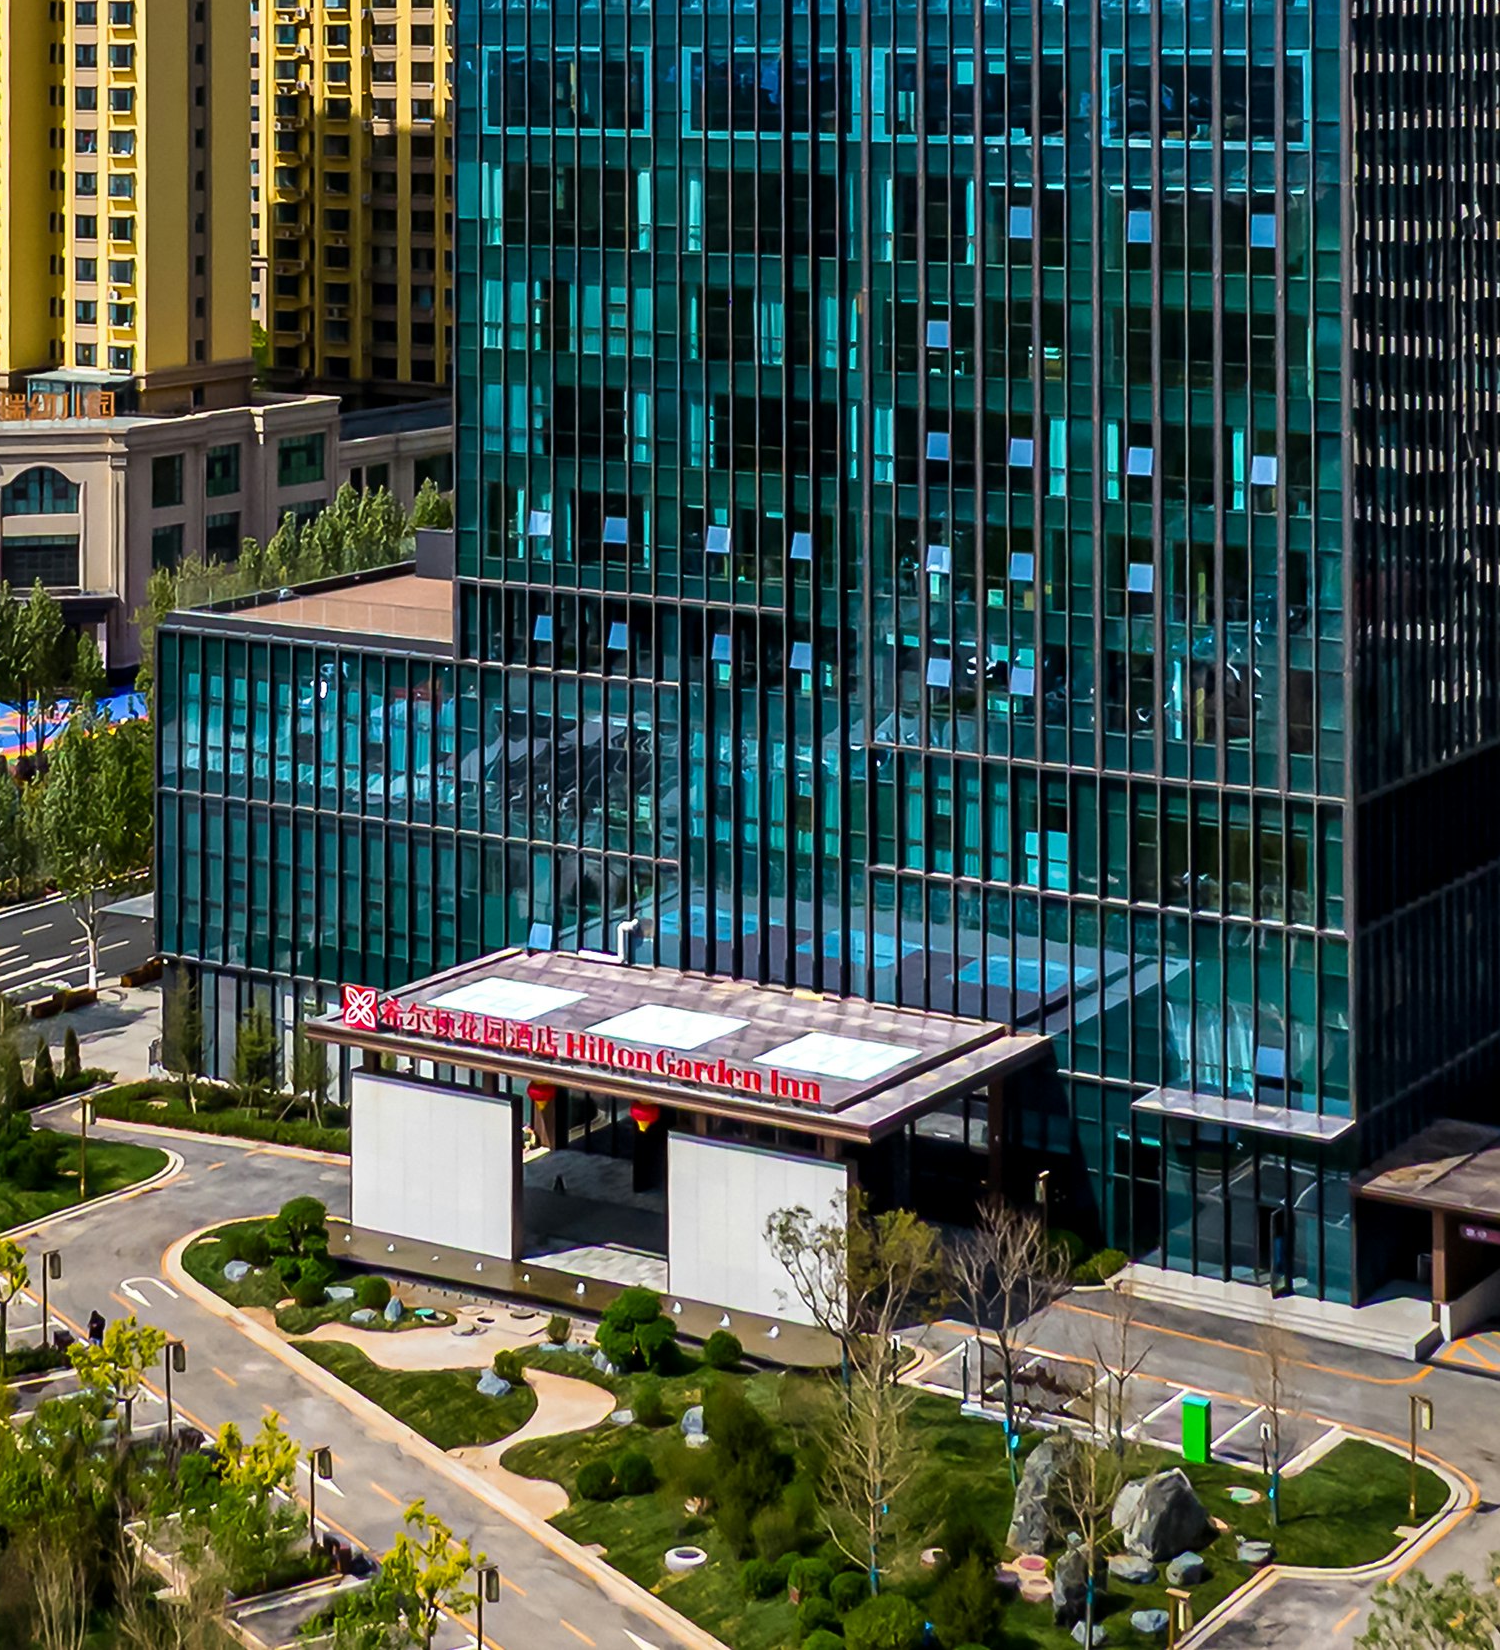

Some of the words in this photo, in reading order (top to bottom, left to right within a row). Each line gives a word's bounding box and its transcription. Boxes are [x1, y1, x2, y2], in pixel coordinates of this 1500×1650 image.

[380, 995, 559, 1058] 希尔顿花园酒店
[564, 1030, 652, 1074] Hilton
[656, 1048, 763, 1094] Garden
[769, 1067, 822, 1105] Inn
